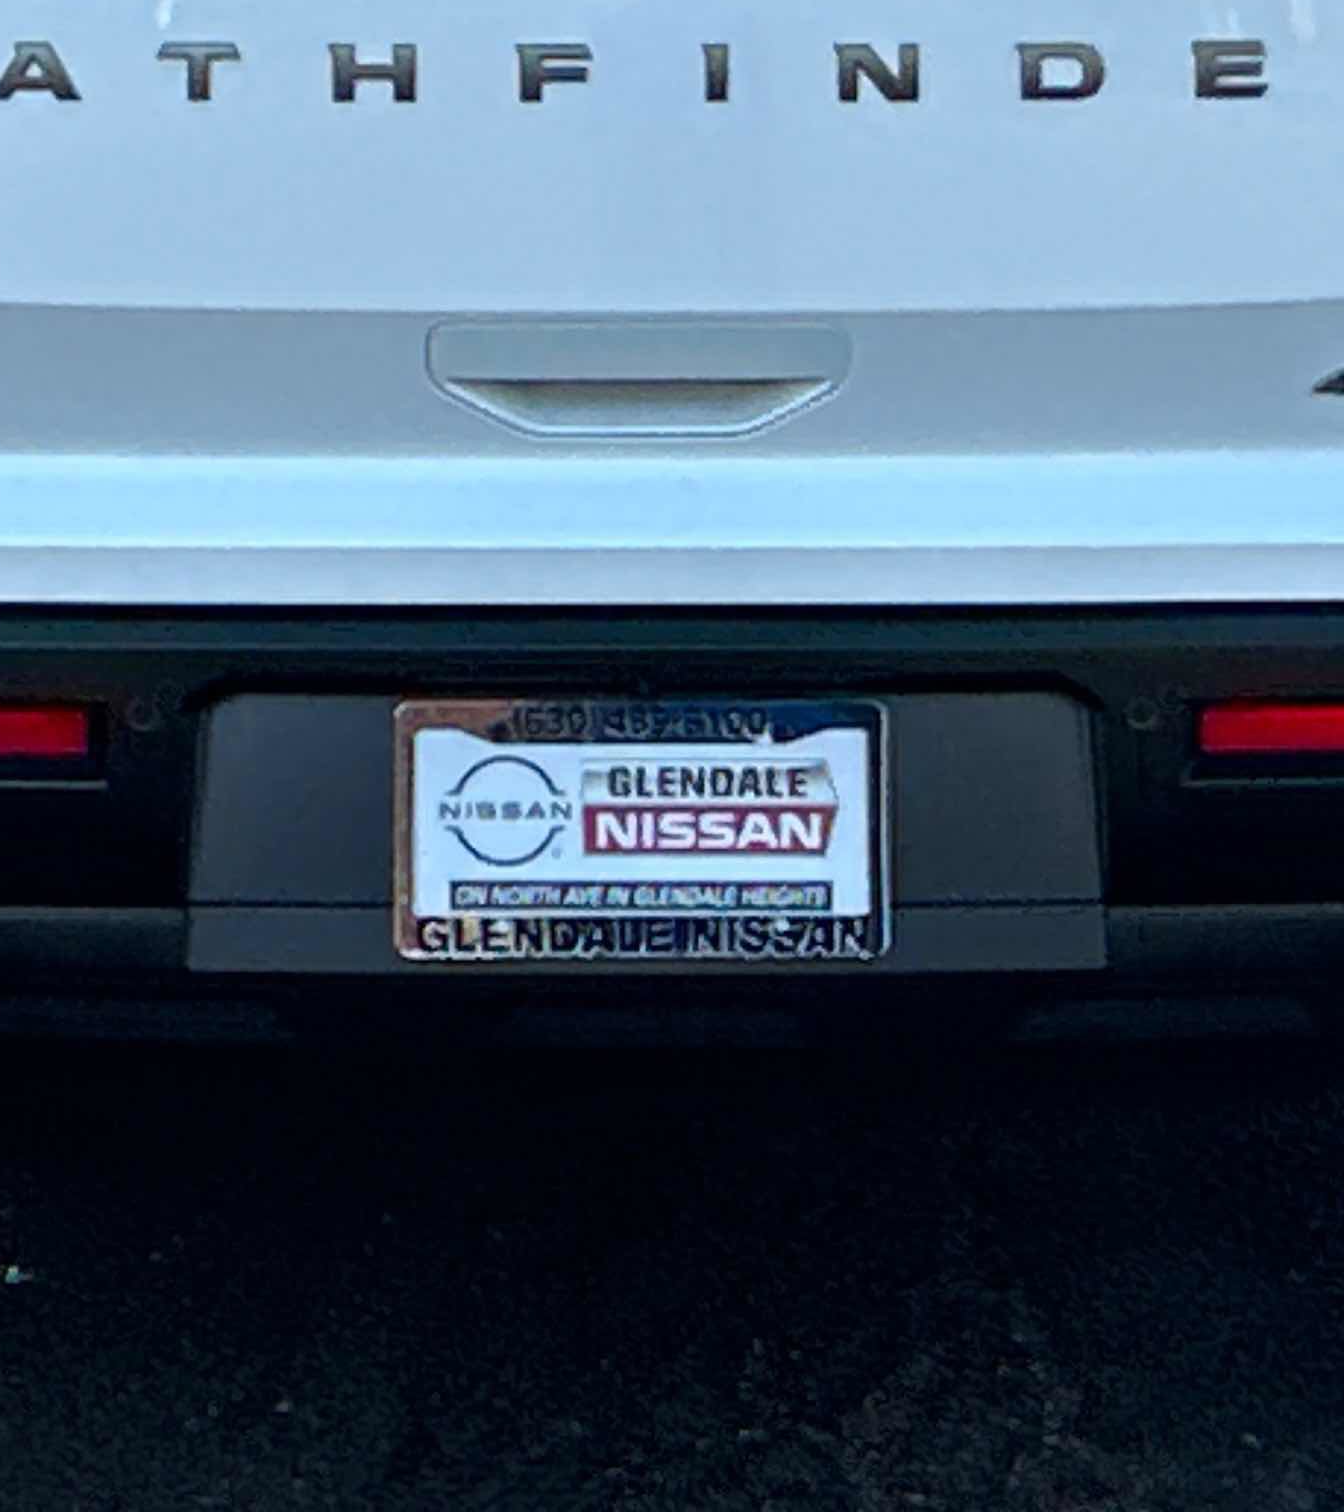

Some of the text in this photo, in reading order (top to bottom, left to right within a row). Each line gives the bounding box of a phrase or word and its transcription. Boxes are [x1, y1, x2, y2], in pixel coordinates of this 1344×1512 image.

[606, 765, 810, 799] GLENDALE
[439, 802, 574, 821] NISSAN
[595, 811, 824, 850] NISSAN
[416, 916, 870, 956] GLENDALE NISSAN
